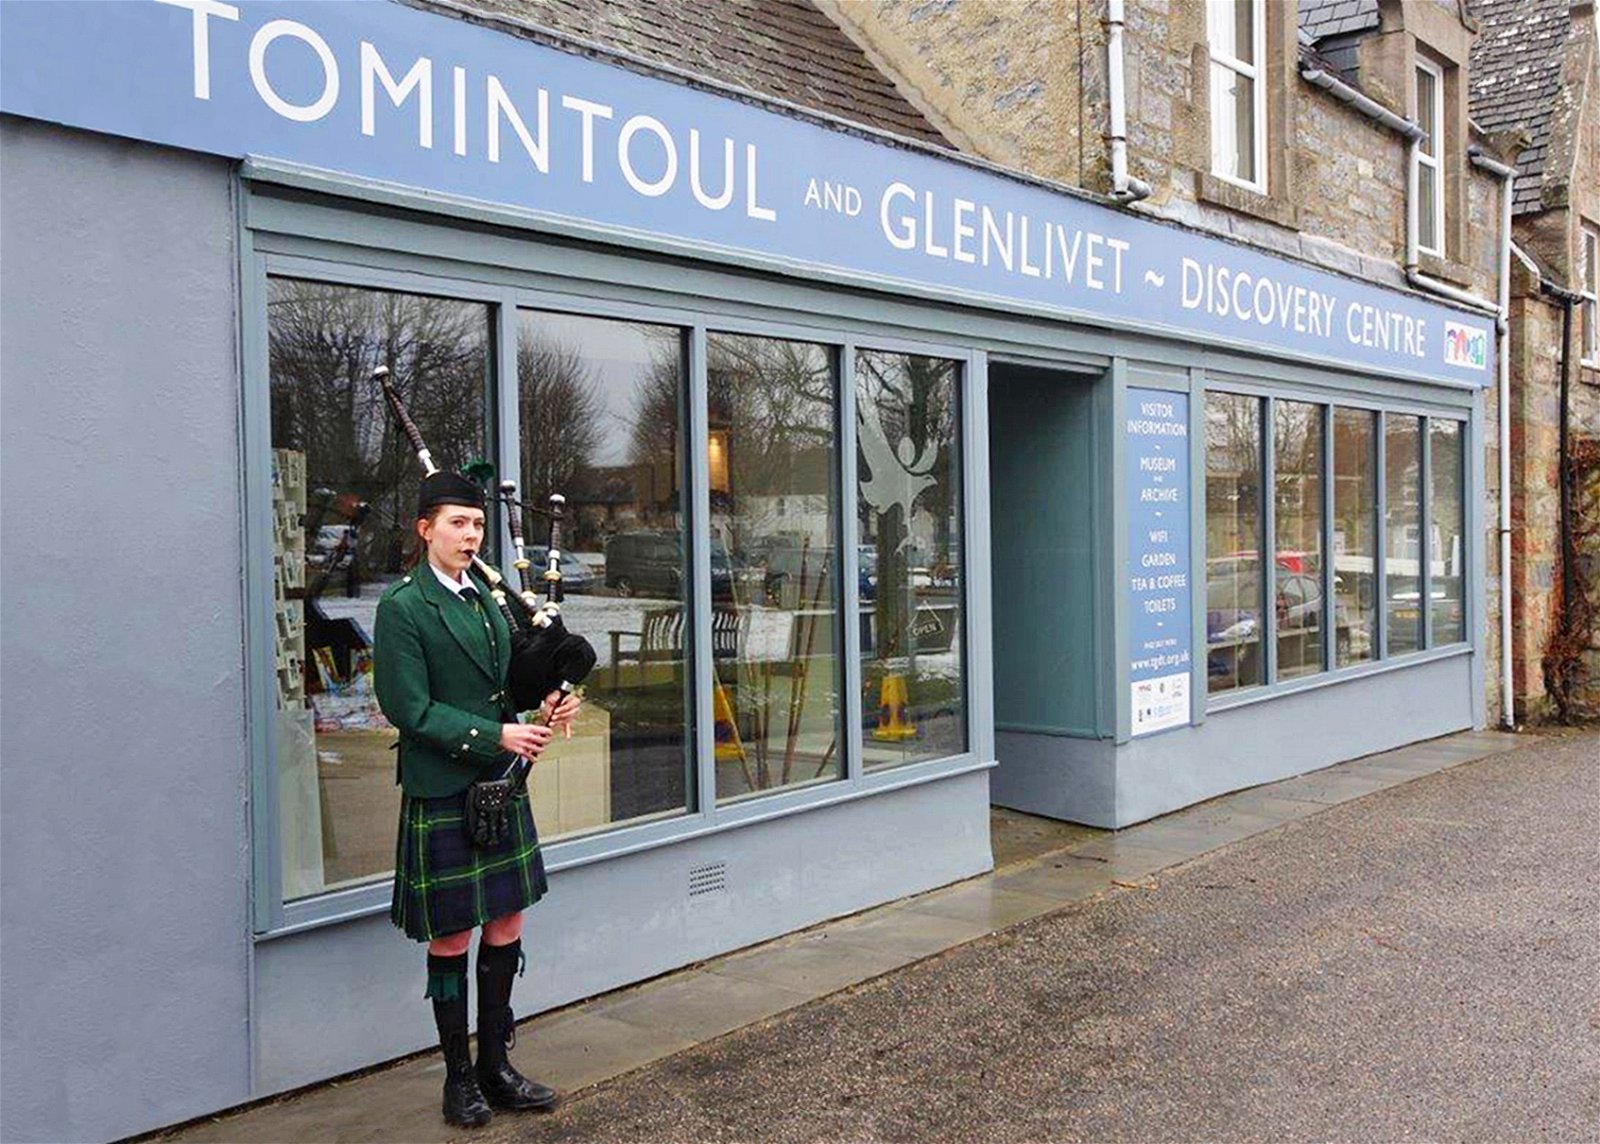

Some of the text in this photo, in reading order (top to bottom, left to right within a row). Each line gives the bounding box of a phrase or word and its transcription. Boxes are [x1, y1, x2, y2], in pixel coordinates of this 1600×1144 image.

[155, 0, 775, 222] TOMINTOUL
[804, 178, 862, 216] AND
[881, 182, 1130, 294] GLENLIVET
[1182, 257, 1337, 338] DISCOVERY
[1346, 302, 1426, 358] CENTRE
[1140, 402, 1173, 417] VISITOR
[1127, 420, 1187, 436] INFORMATION
[1140, 457, 1176, 471] MUSEUM
[1140, 488, 1178, 502] ARCHIVE
[1148, 530, 1168, 542] WIFI
[1141, 552, 1176, 567] GARDEN
[1131, 574, 1186, 591] TEA & COFFEE
[1144, 598, 1176, 613] TOILETS
[912, 623, 937, 636] OPEN
